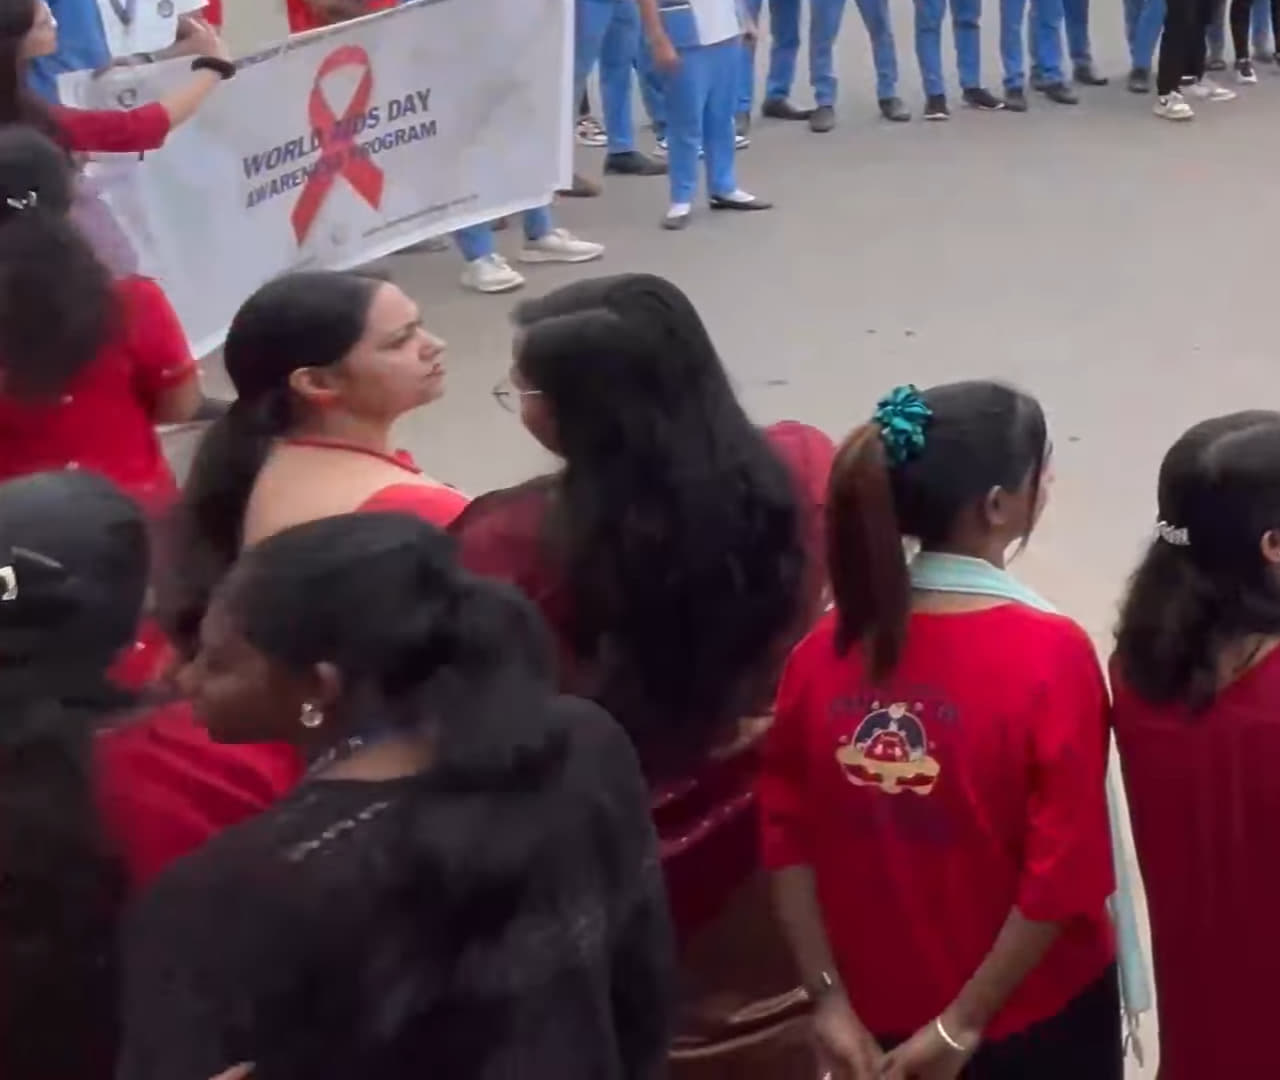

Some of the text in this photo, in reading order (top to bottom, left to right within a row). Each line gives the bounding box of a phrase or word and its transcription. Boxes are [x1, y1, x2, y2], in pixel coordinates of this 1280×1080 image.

[243, 87, 431, 179] WORLD AIDS DAY
[350, 119, 437, 159] PROGRAM
